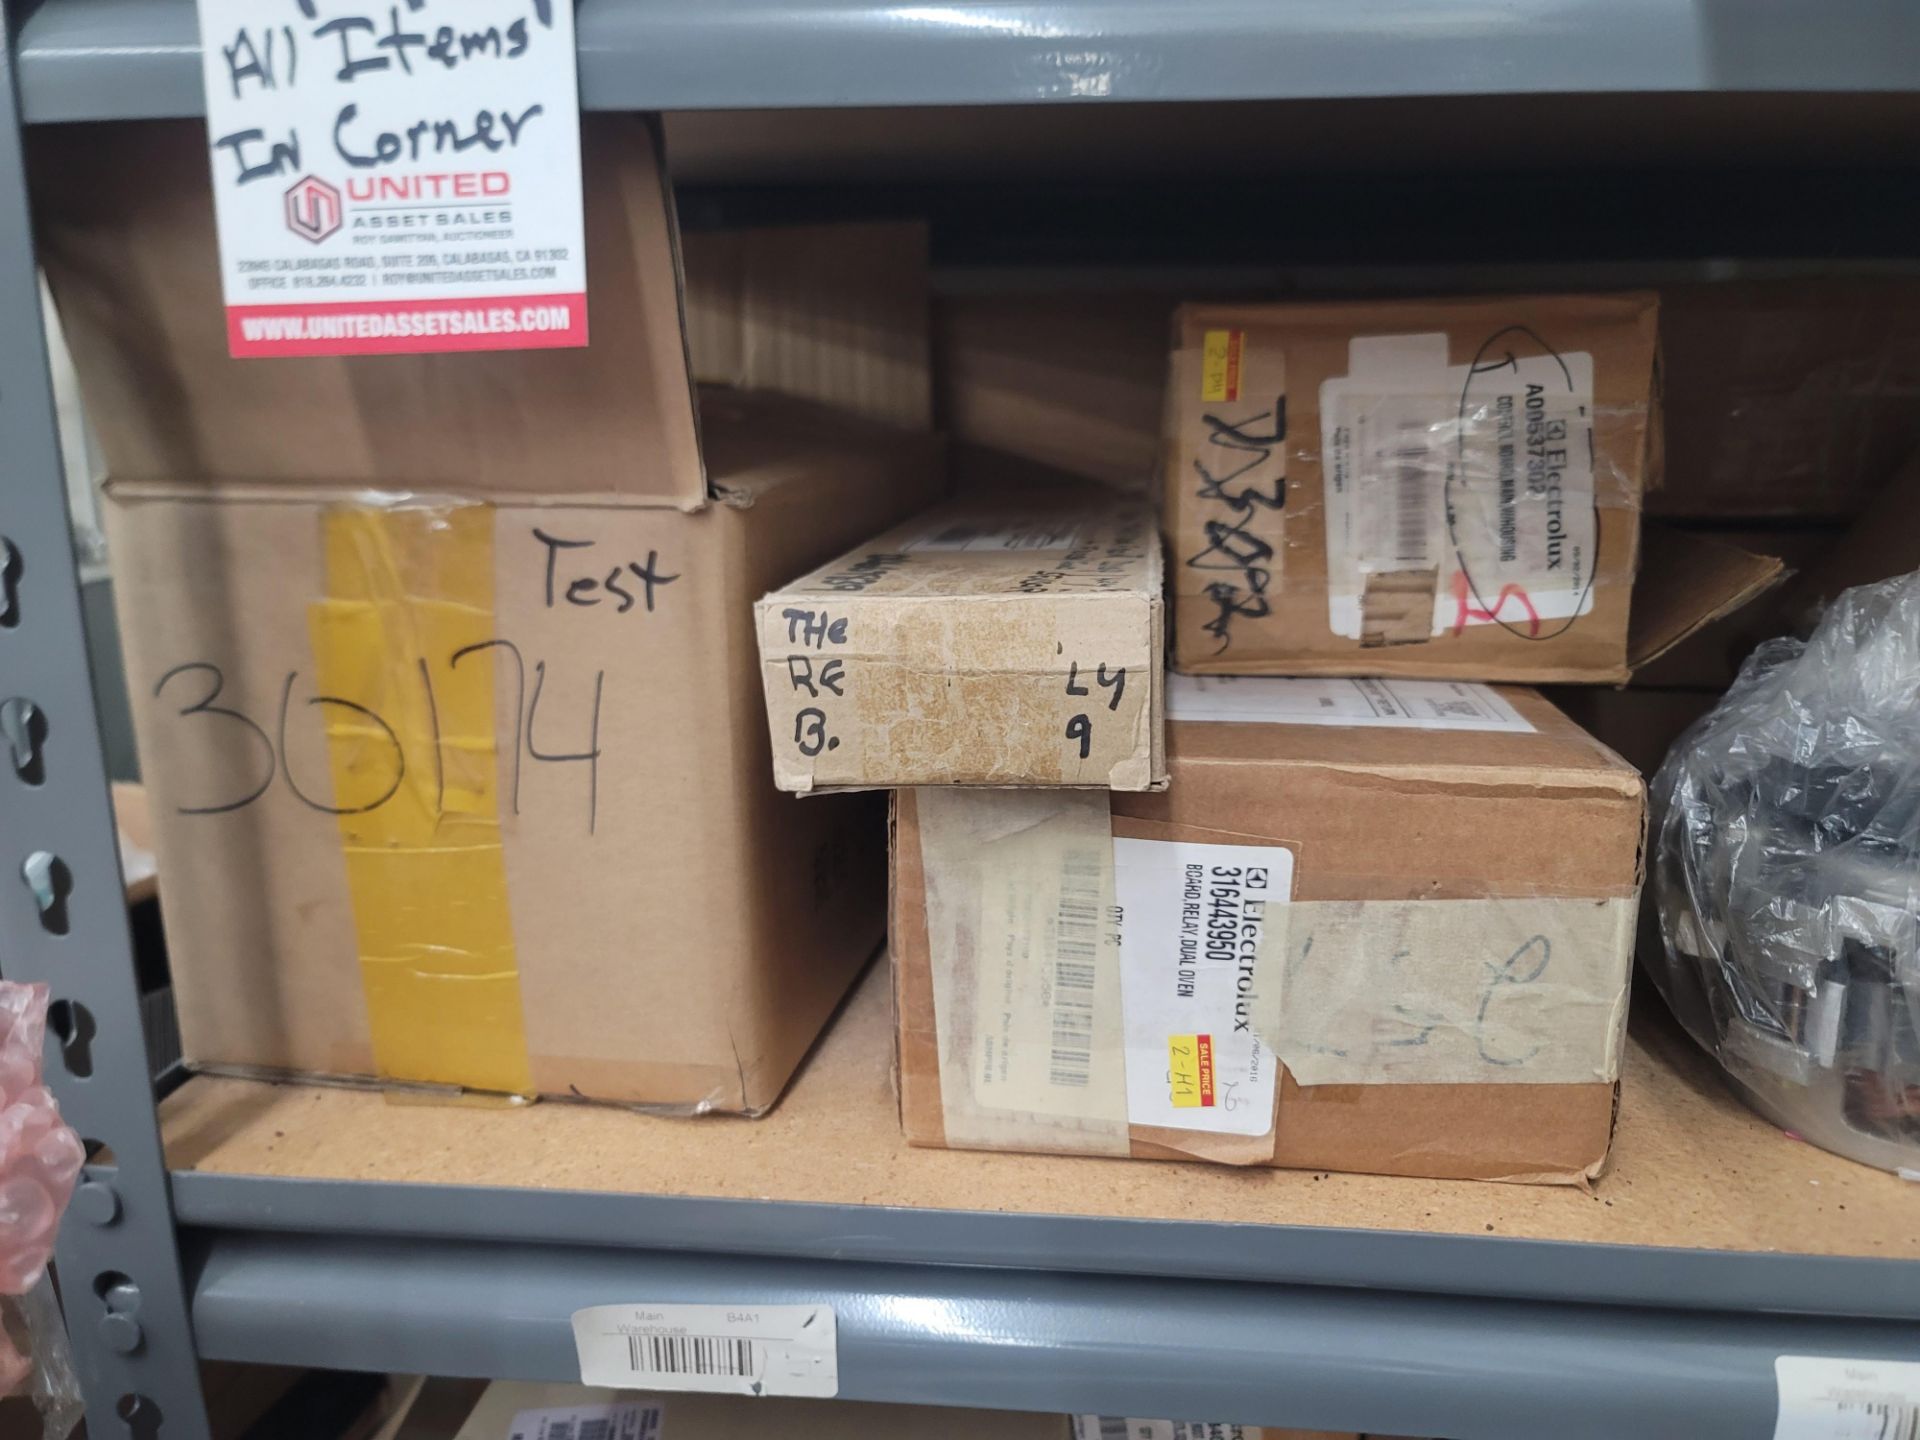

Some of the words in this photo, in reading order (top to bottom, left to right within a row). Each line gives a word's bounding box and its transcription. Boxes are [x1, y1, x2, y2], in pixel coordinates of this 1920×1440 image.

[334, 103, 543, 168] Corner
[346, 171, 511, 201] UNITED
[352, 213, 429, 229] ASSET
[436, 210, 513, 226] SALES
[442, 229, 514, 242] AUCTIONEER
[273, 256, 341, 271] CALABASAS
[516, 249, 531, 263] CA
[248, 276, 287, 289] OFFICE
[240, 307, 570, 342] WWW.UNITEDASSETSALES.COM
[1546, 448, 1568, 571] Electrolux
[532, 528, 680, 613] Test
[1205, 866, 1242, 961] 316443950
[1234, 898, 1265, 1033] Electrolux
[1177, 969, 1195, 998] OVEN
[1199, 1042, 1209, 1066] SALE
[1201, 1068, 1211, 1095] PRICE
[616, 1323, 688, 1335] Warehouse
[634, 1310, 665, 1322] Main
[726, 1311, 760, 1323] B4A1
